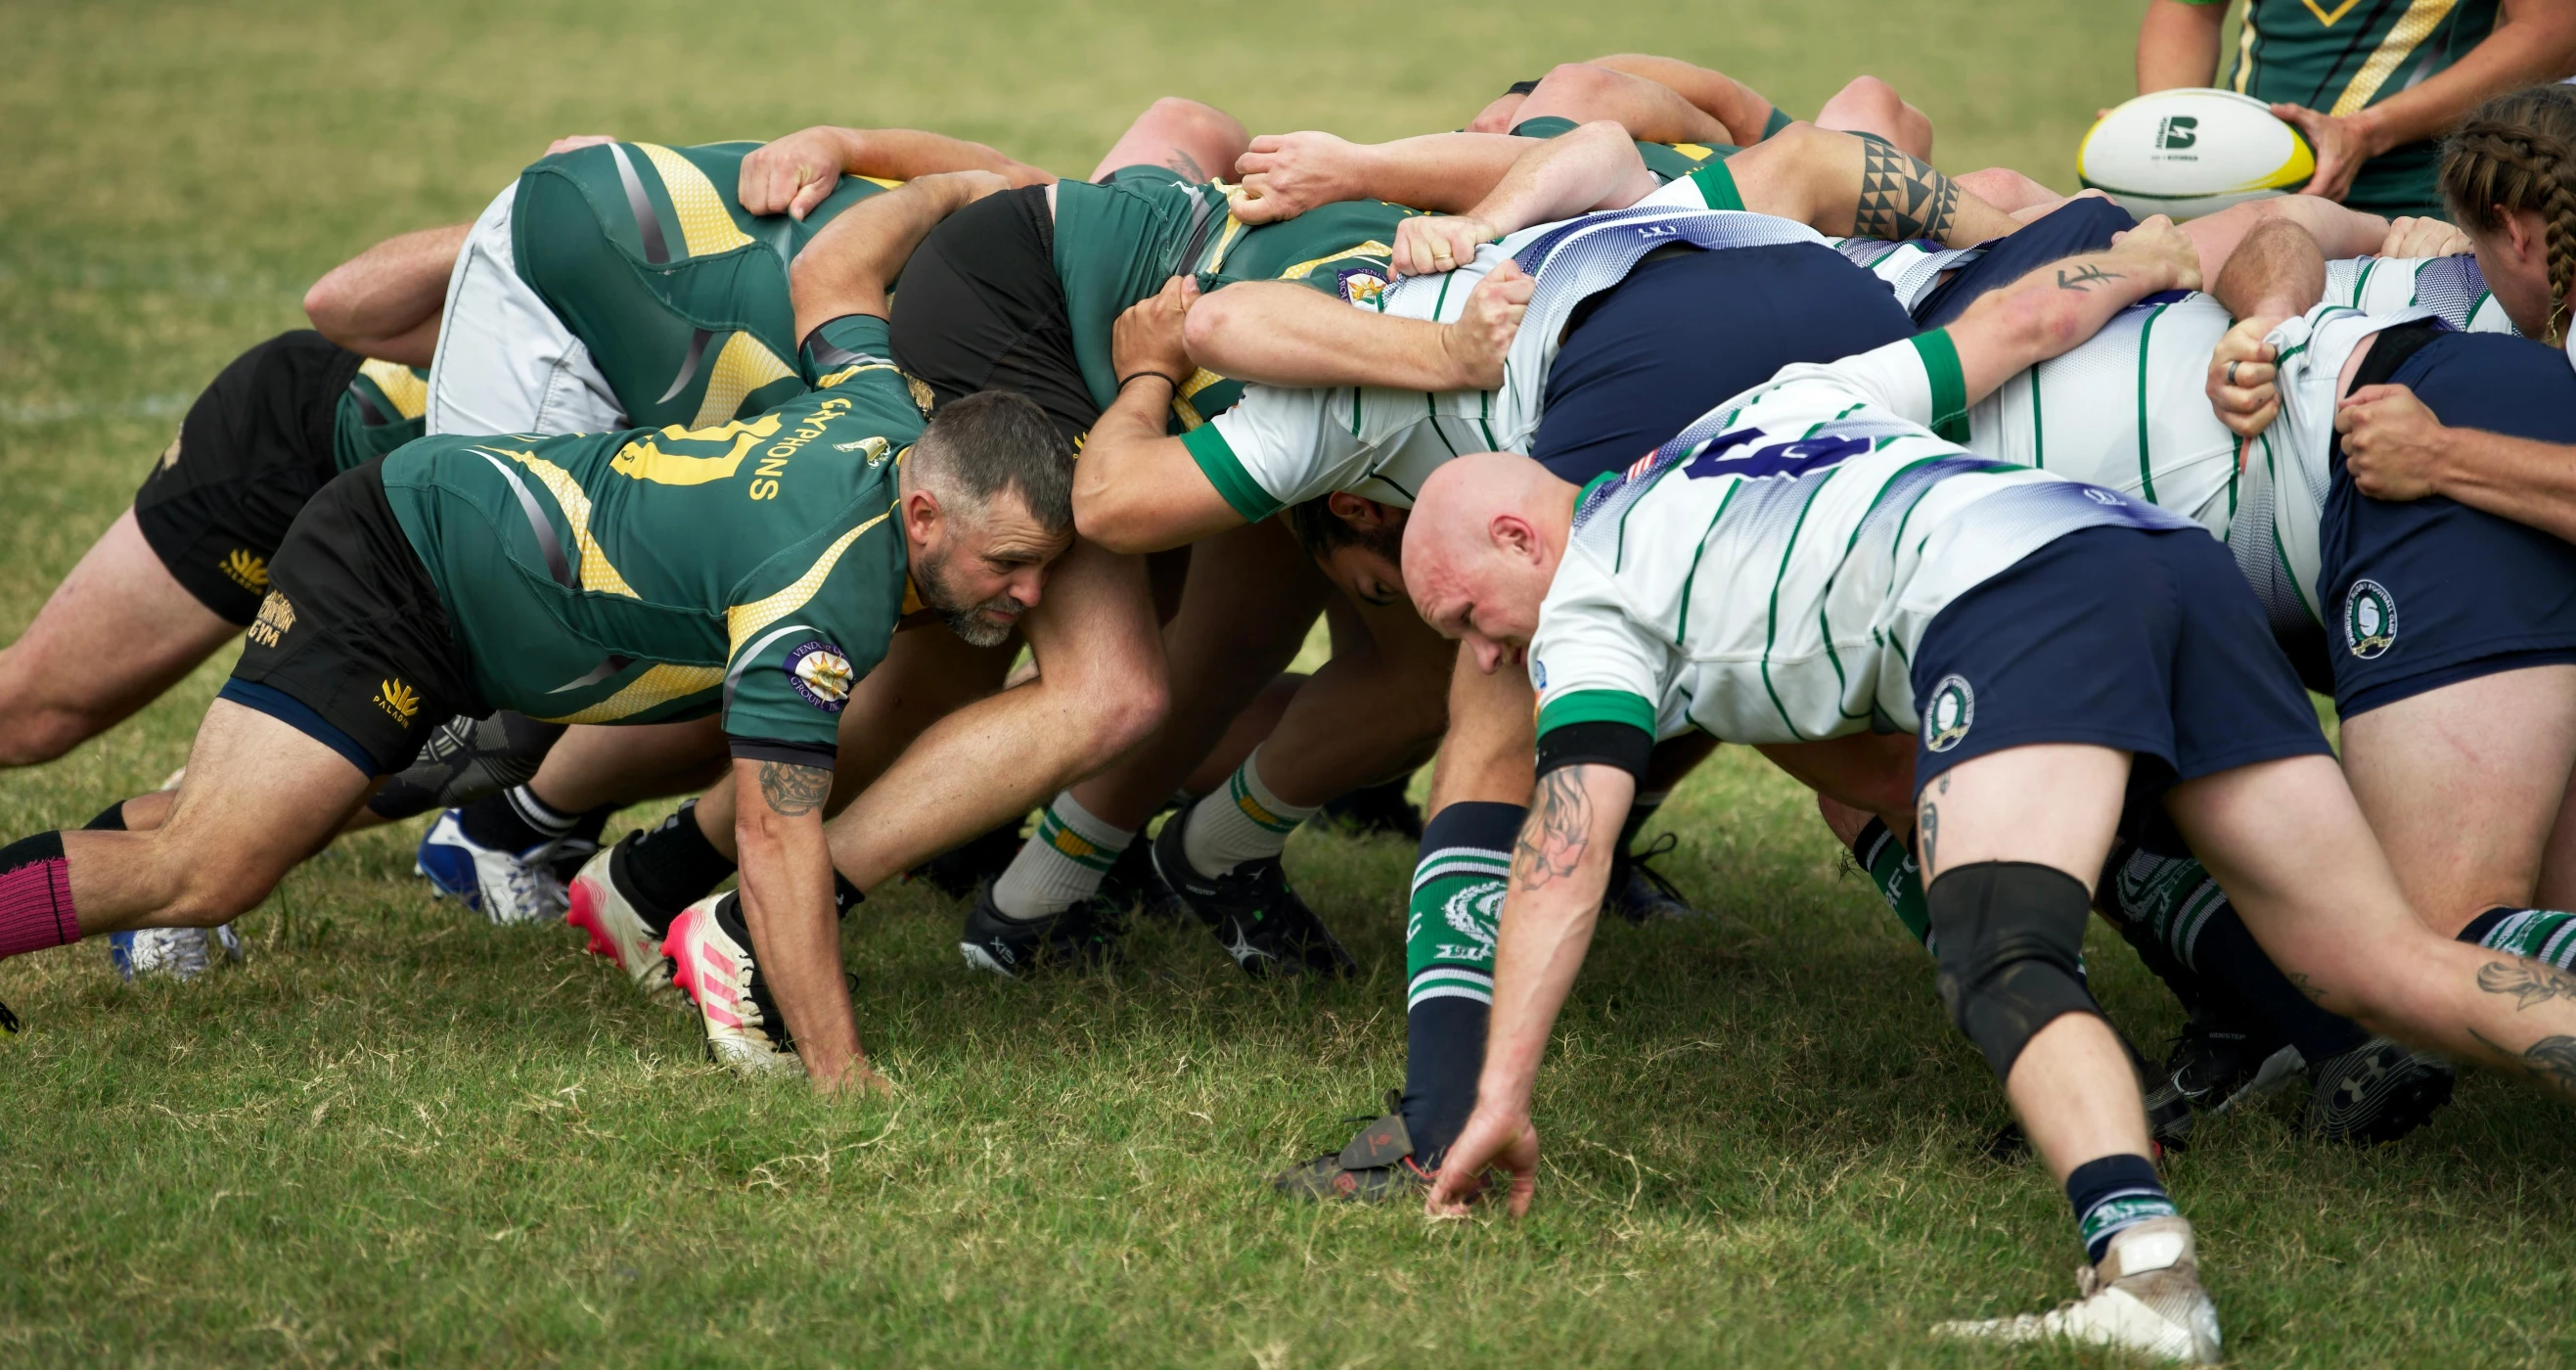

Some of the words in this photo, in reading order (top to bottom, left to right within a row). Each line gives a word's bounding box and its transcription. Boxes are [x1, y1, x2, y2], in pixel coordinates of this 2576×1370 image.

[1358, 268, 1392, 284] VENDO
[749, 397, 852, 500] GRYPHONS
[2368, 583, 2393, 613] FOOTBALL
[2387, 614, 2396, 635] CLUB
[248, 618, 281, 648] GYM
[792, 641, 832, 658] VENDOR
[372, 695, 409, 729] PALADIN
